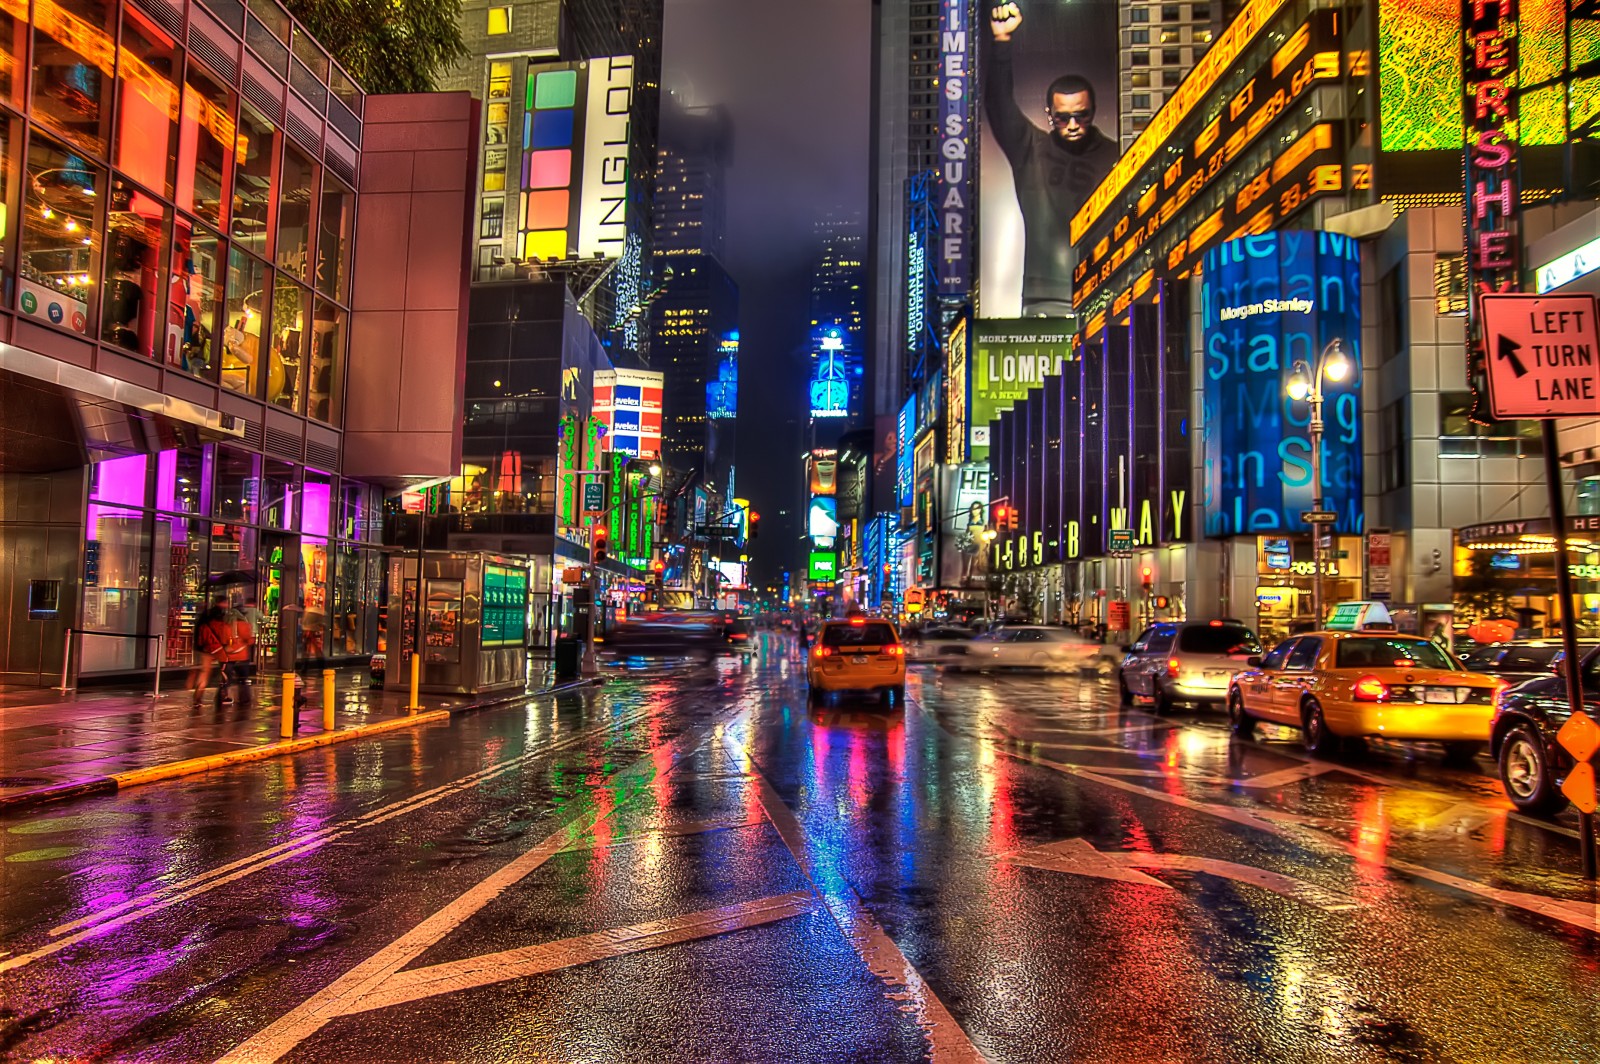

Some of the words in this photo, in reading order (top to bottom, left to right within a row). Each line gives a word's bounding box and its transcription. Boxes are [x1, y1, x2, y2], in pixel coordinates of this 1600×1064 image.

[598, 56, 632, 243] INGLOT
[942, 113, 966, 259] SQUARE
[908, 231, 917, 276] EAGLE
[916, 247, 924, 332] OUTFITTERS
[908, 278, 917, 351] AMERICAN
[1220, 302, 1263, 321] Morgan
[1263, 297, 1314, 314] Stanley
[1530, 311, 1584, 334] LEFT
[979, 335, 1007, 343] MORE
[1009, 335, 1036, 343] THAN
[1038, 335, 1063, 343] JUST
[1531, 344, 1591, 367] TURN
[1536, 377, 1595, 400] LANE
[810, 409, 848, 417] TOSHIBA
[994, 531, 1043, 570] 1585
[814, 561, 832, 570] FOX
